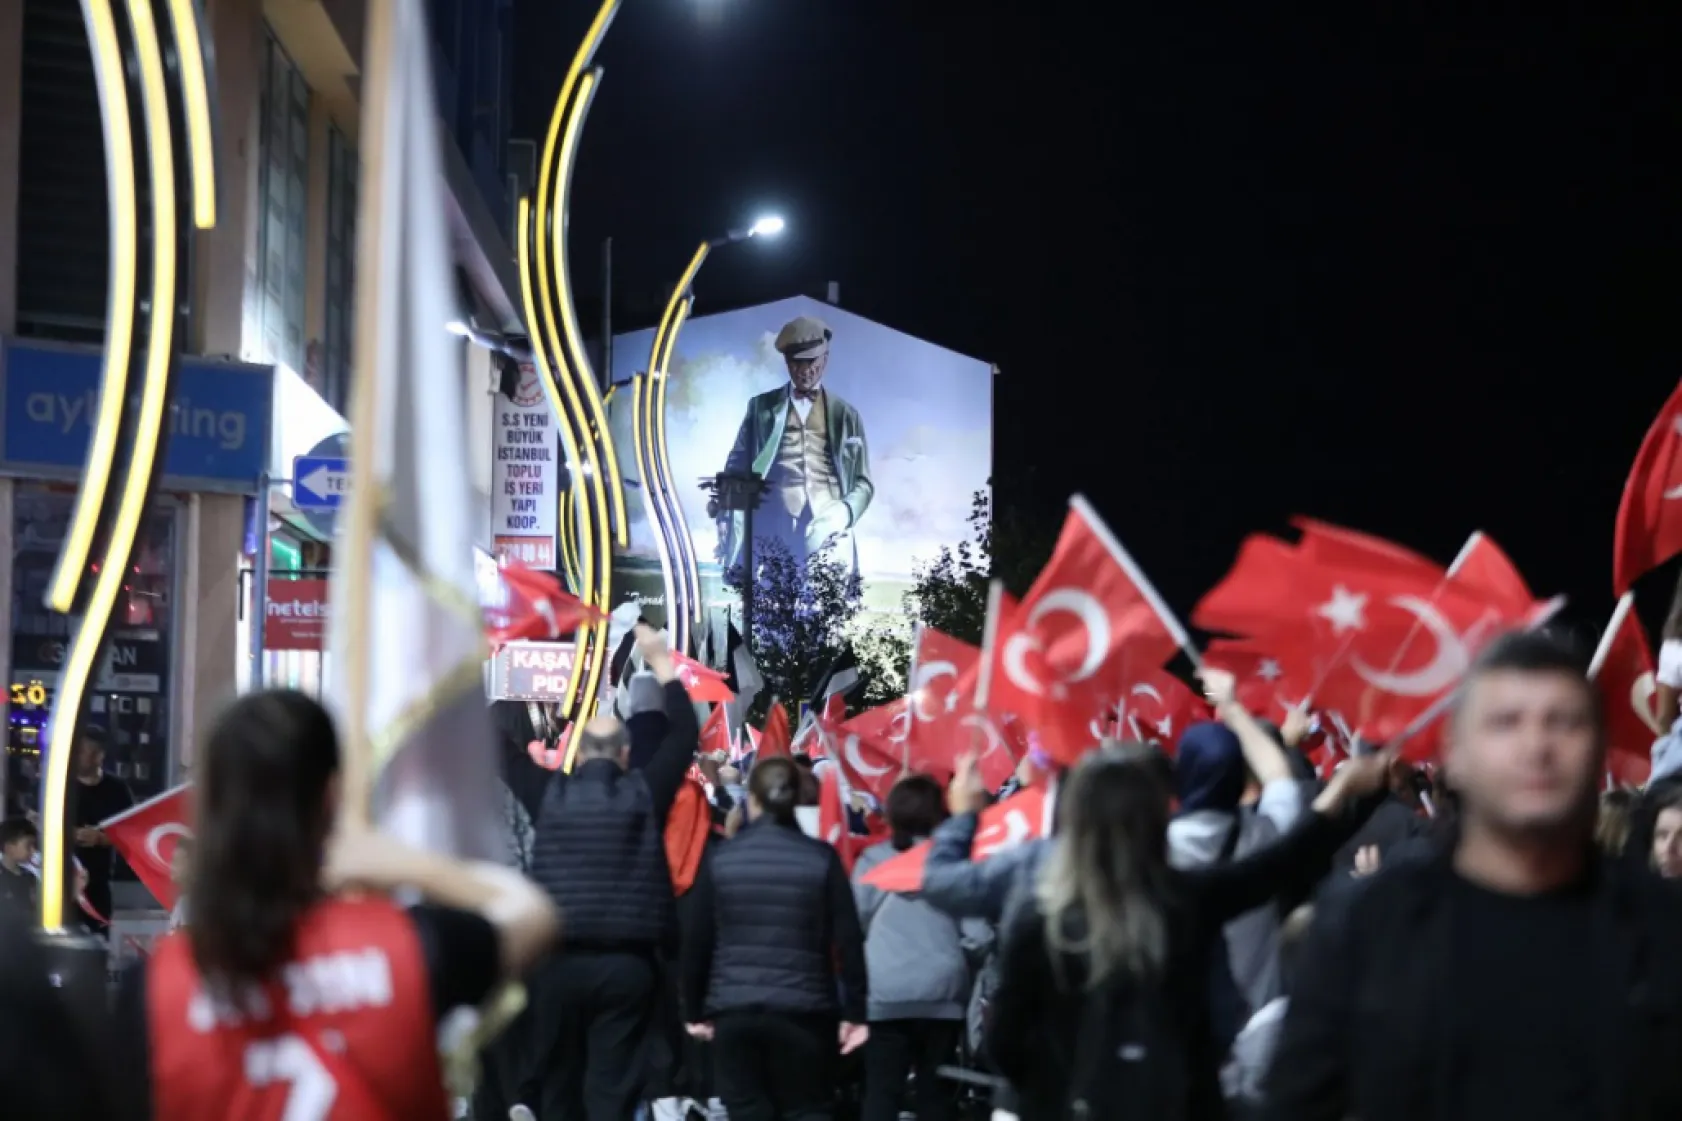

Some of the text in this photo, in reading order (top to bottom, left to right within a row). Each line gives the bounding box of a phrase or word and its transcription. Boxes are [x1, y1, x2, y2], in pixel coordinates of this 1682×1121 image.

[507, 428, 543, 443] BÜYÜK
[498, 445, 551, 461] İSTANBUL
[507, 465, 541, 478] TOPLU
[519, 481, 543, 495] YERİ
[511, 499, 536, 513] YAPI
